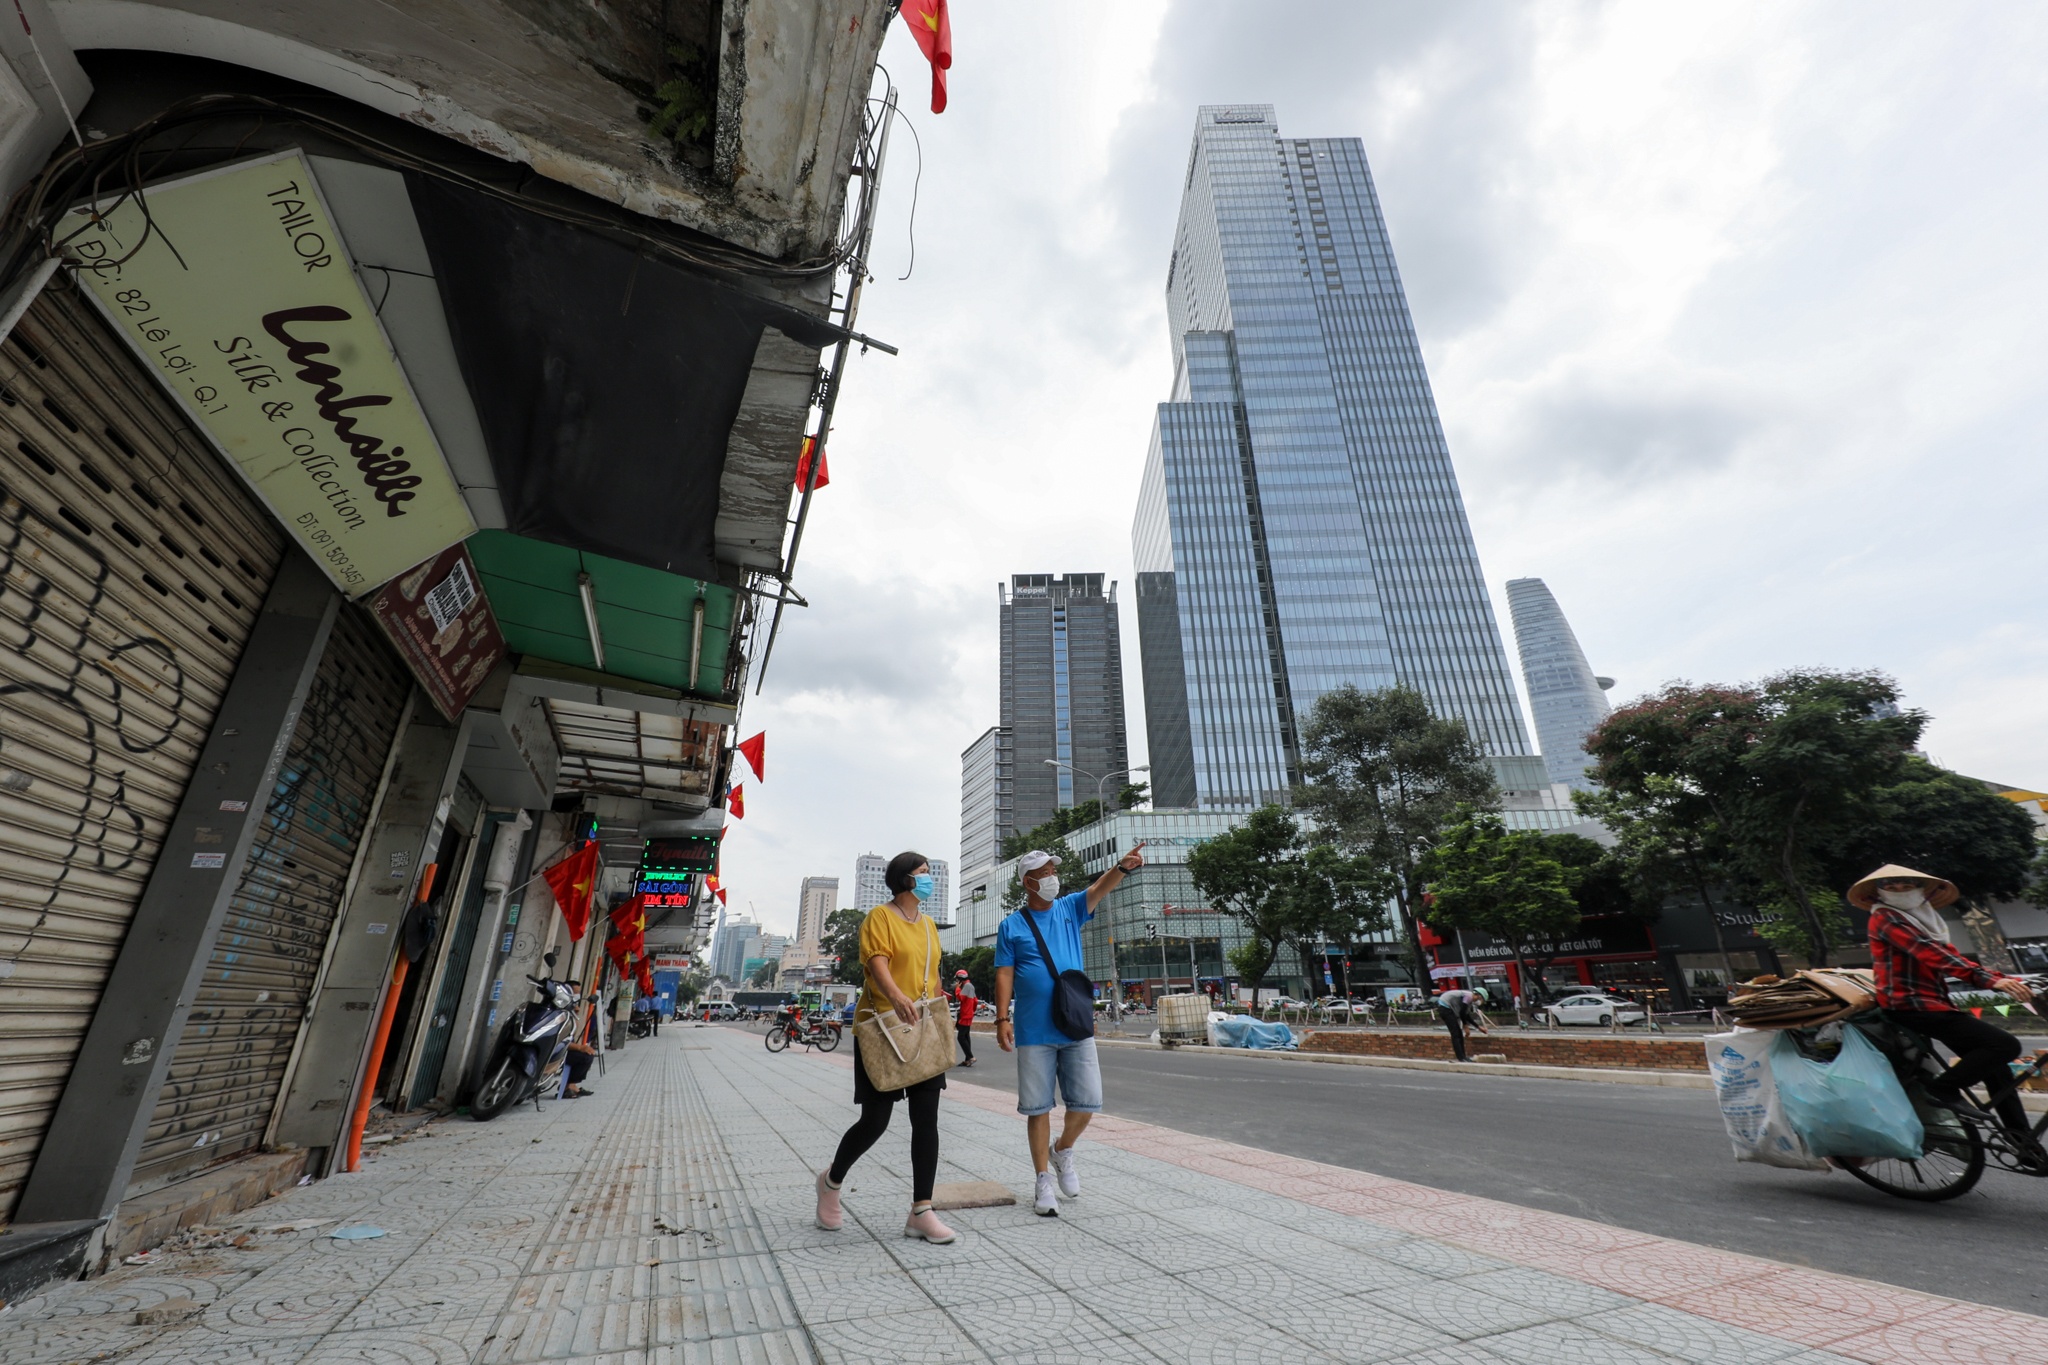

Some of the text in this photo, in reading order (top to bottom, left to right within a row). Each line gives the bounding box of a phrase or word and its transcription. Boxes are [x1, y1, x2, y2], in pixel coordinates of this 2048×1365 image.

[1217, 112, 1262, 121] Keppel
[267, 181, 332, 273] TAILOR
[74, 240, 121, 285] ĐC:
[115, 289, 150, 316] 82
[137, 317, 170, 342] Lê
[160, 345, 196, 374] Lợi
[194, 386, 228, 414] Q.1
[214, 337, 365, 530] Silk & Collection
[297, 512, 365, 585] ĐT: 091 509 3457
[1017, 586, 1046, 594] Keppel
[374, 597, 390, 614] 82
[638, 880, 689, 893] SÀI GÒN
[644, 894, 662, 904] IM
[1499, 945, 1513, 955] CÔN
[1573, 939, 1588, 950] GIÁ
[1587, 937, 1603, 949] TỐT
